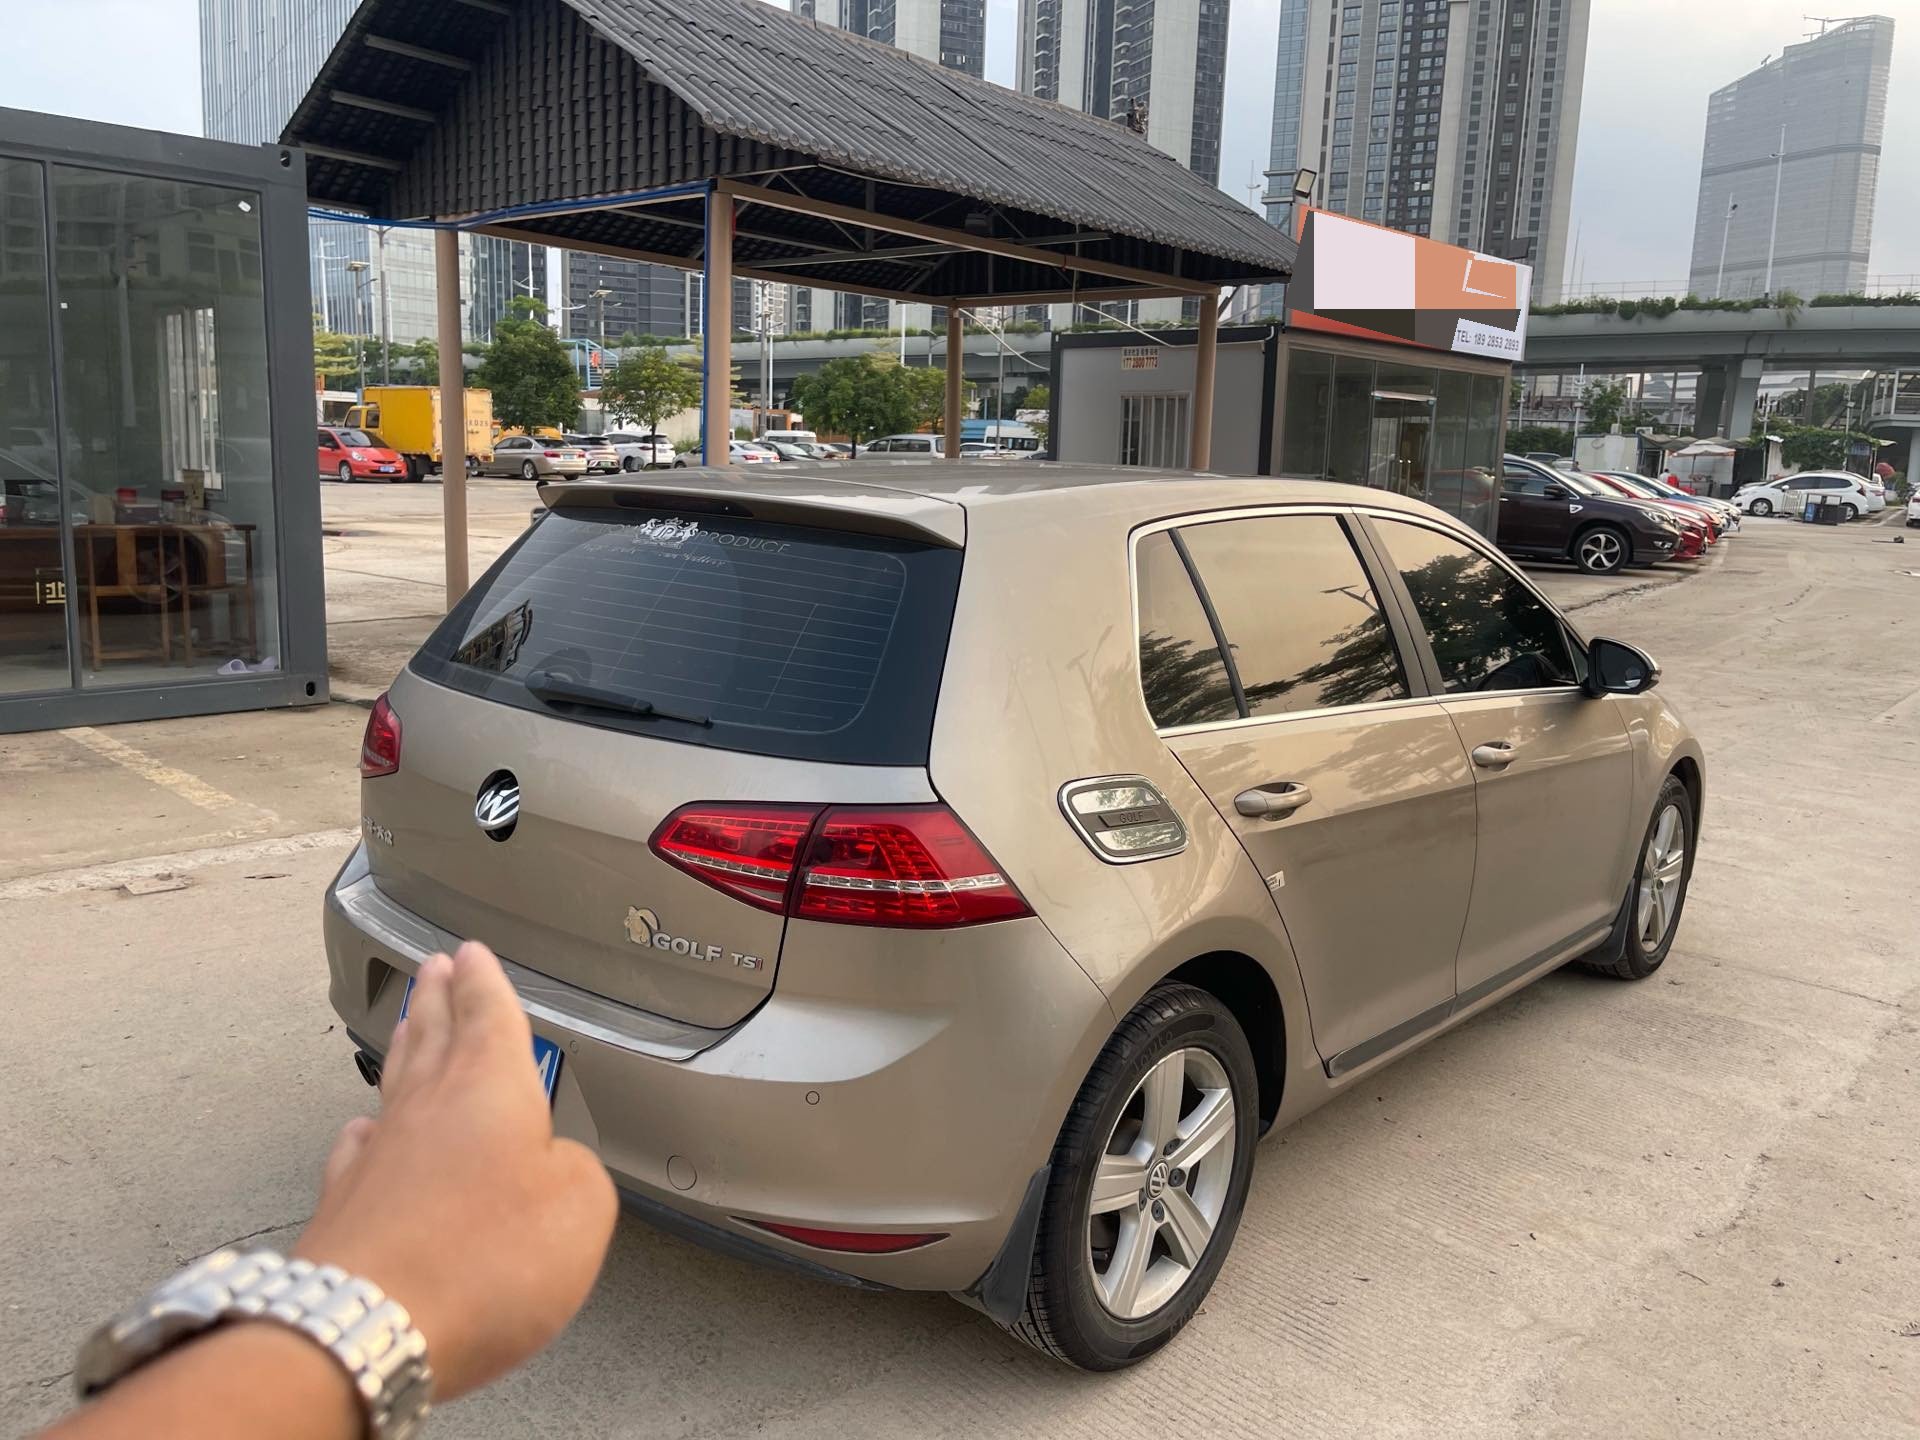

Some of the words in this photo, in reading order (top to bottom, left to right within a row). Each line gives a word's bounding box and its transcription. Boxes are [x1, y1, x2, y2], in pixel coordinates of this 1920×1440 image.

[1474, 333, 1486, 346] 189
[1119, 812, 1144, 824] GOLF
[652, 932, 723, 962] GOLF
